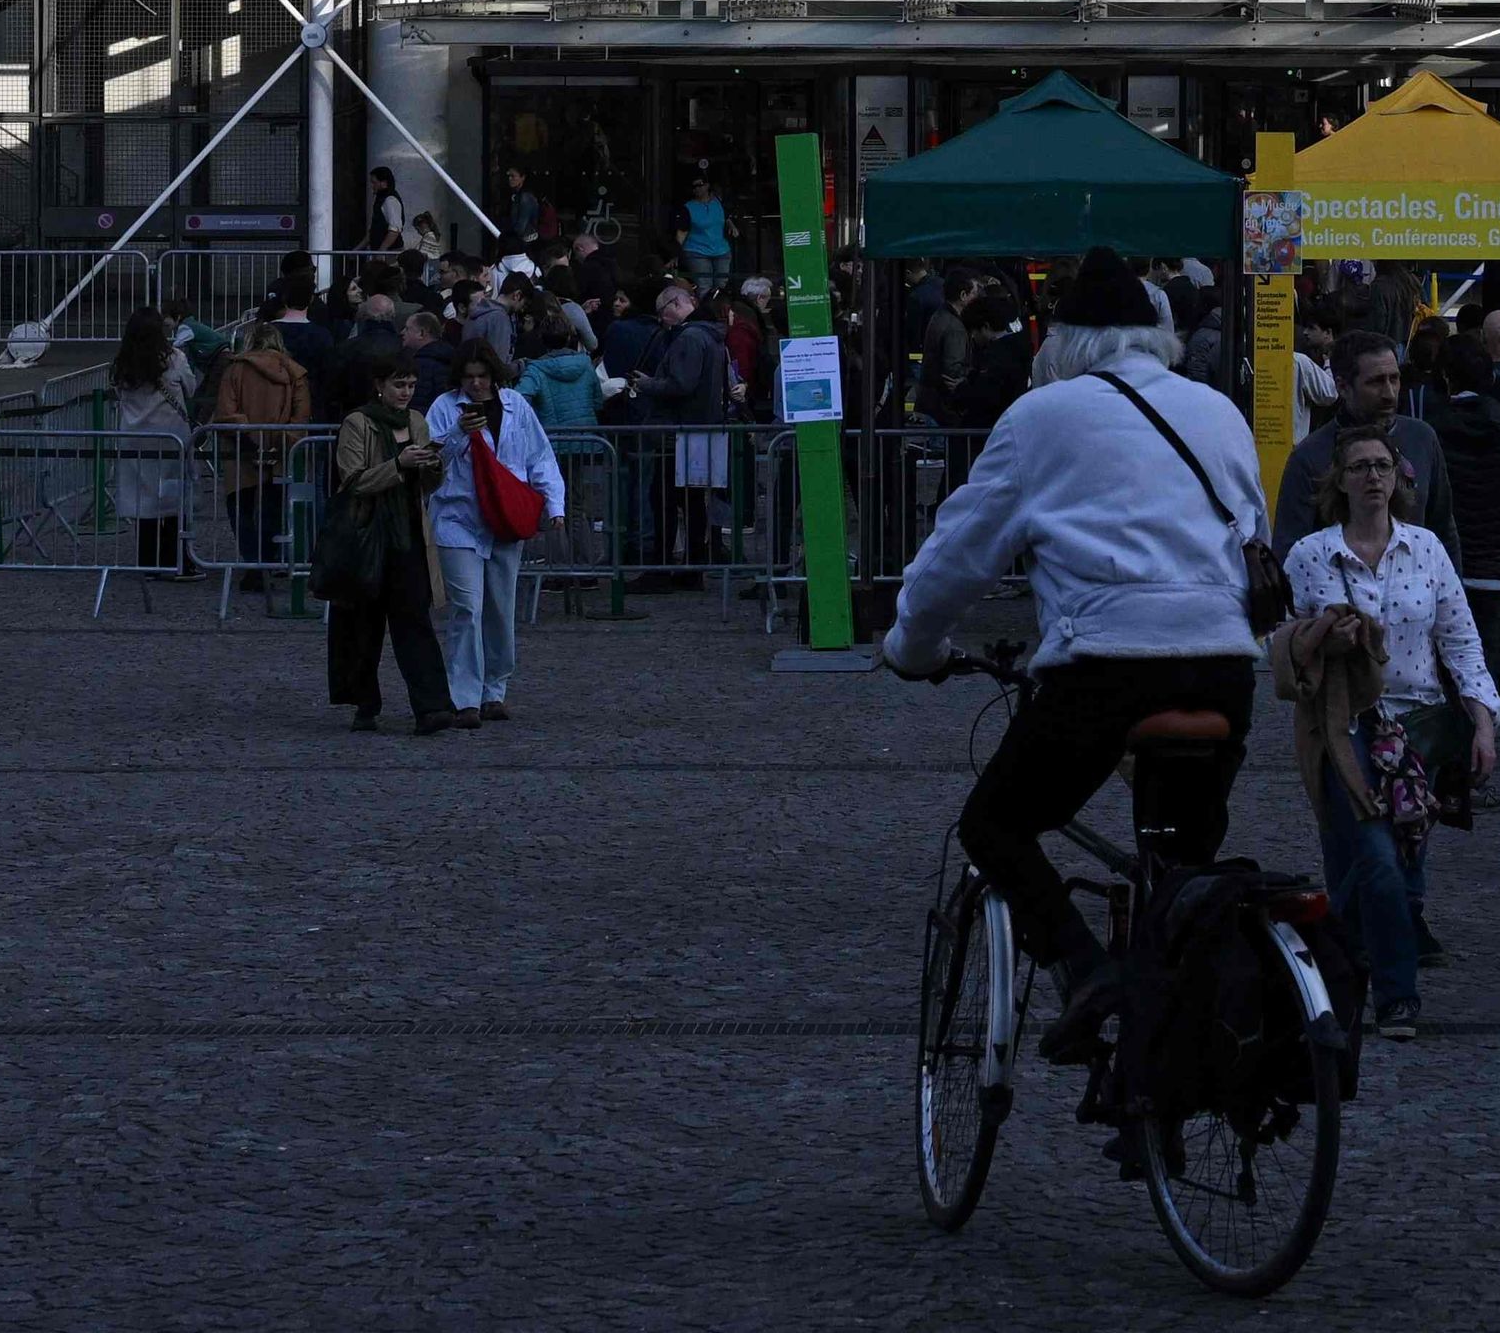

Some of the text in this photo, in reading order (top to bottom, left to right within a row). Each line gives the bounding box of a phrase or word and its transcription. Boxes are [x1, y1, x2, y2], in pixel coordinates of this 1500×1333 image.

[1020, 67, 1028, 80] 5
[1300, 193, 1445, 222] Spectacles,
[1371, 228, 1481, 247] Conférences,
